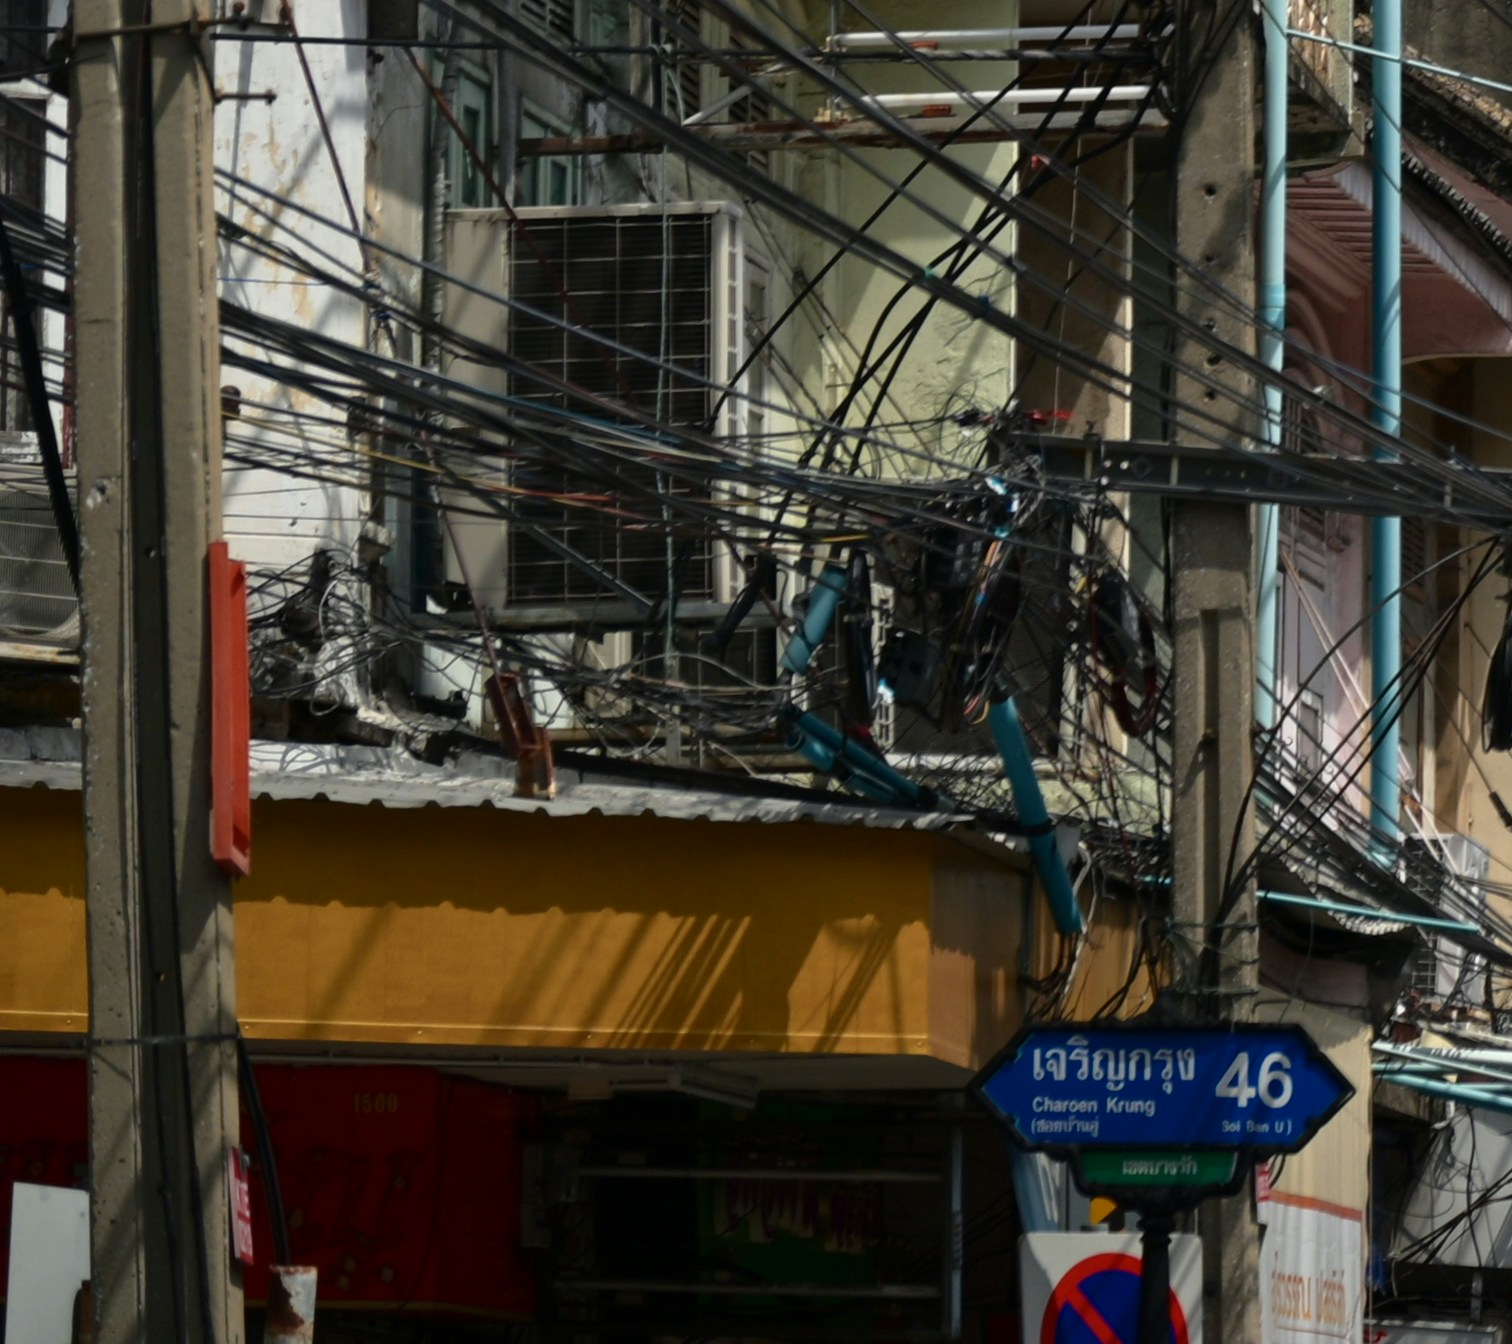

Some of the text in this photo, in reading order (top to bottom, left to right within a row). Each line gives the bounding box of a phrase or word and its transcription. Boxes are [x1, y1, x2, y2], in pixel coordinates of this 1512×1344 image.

[1031, 1034, 1196, 1094] เจริญกรุง
[1214, 1051, 1294, 1110] 46
[1031, 1095, 1157, 1118] Charoen Krung
[1221, 1119, 1241, 1133] Soi
[1246, 1120, 1270, 1133] Ban
